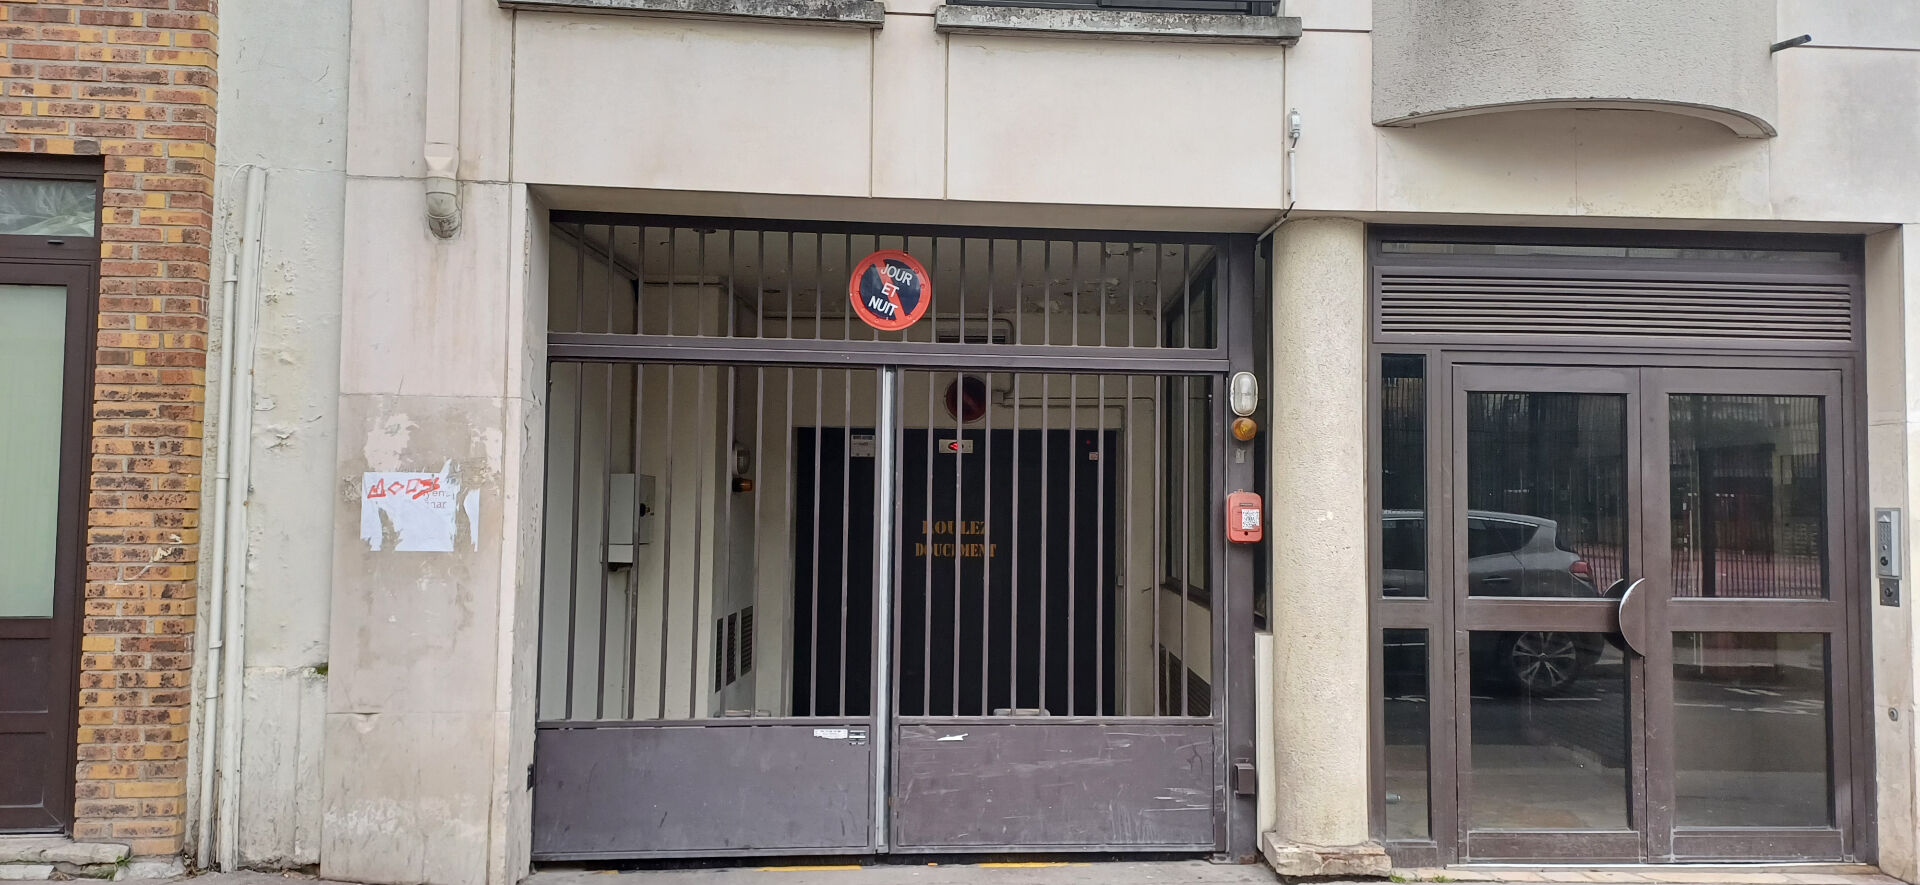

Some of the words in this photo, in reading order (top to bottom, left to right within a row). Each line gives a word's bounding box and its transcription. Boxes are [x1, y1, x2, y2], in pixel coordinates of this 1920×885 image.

[881, 264, 912, 286] JOUR
[881, 282, 899, 297] ET
[868, 296, 898, 316] NUIT
